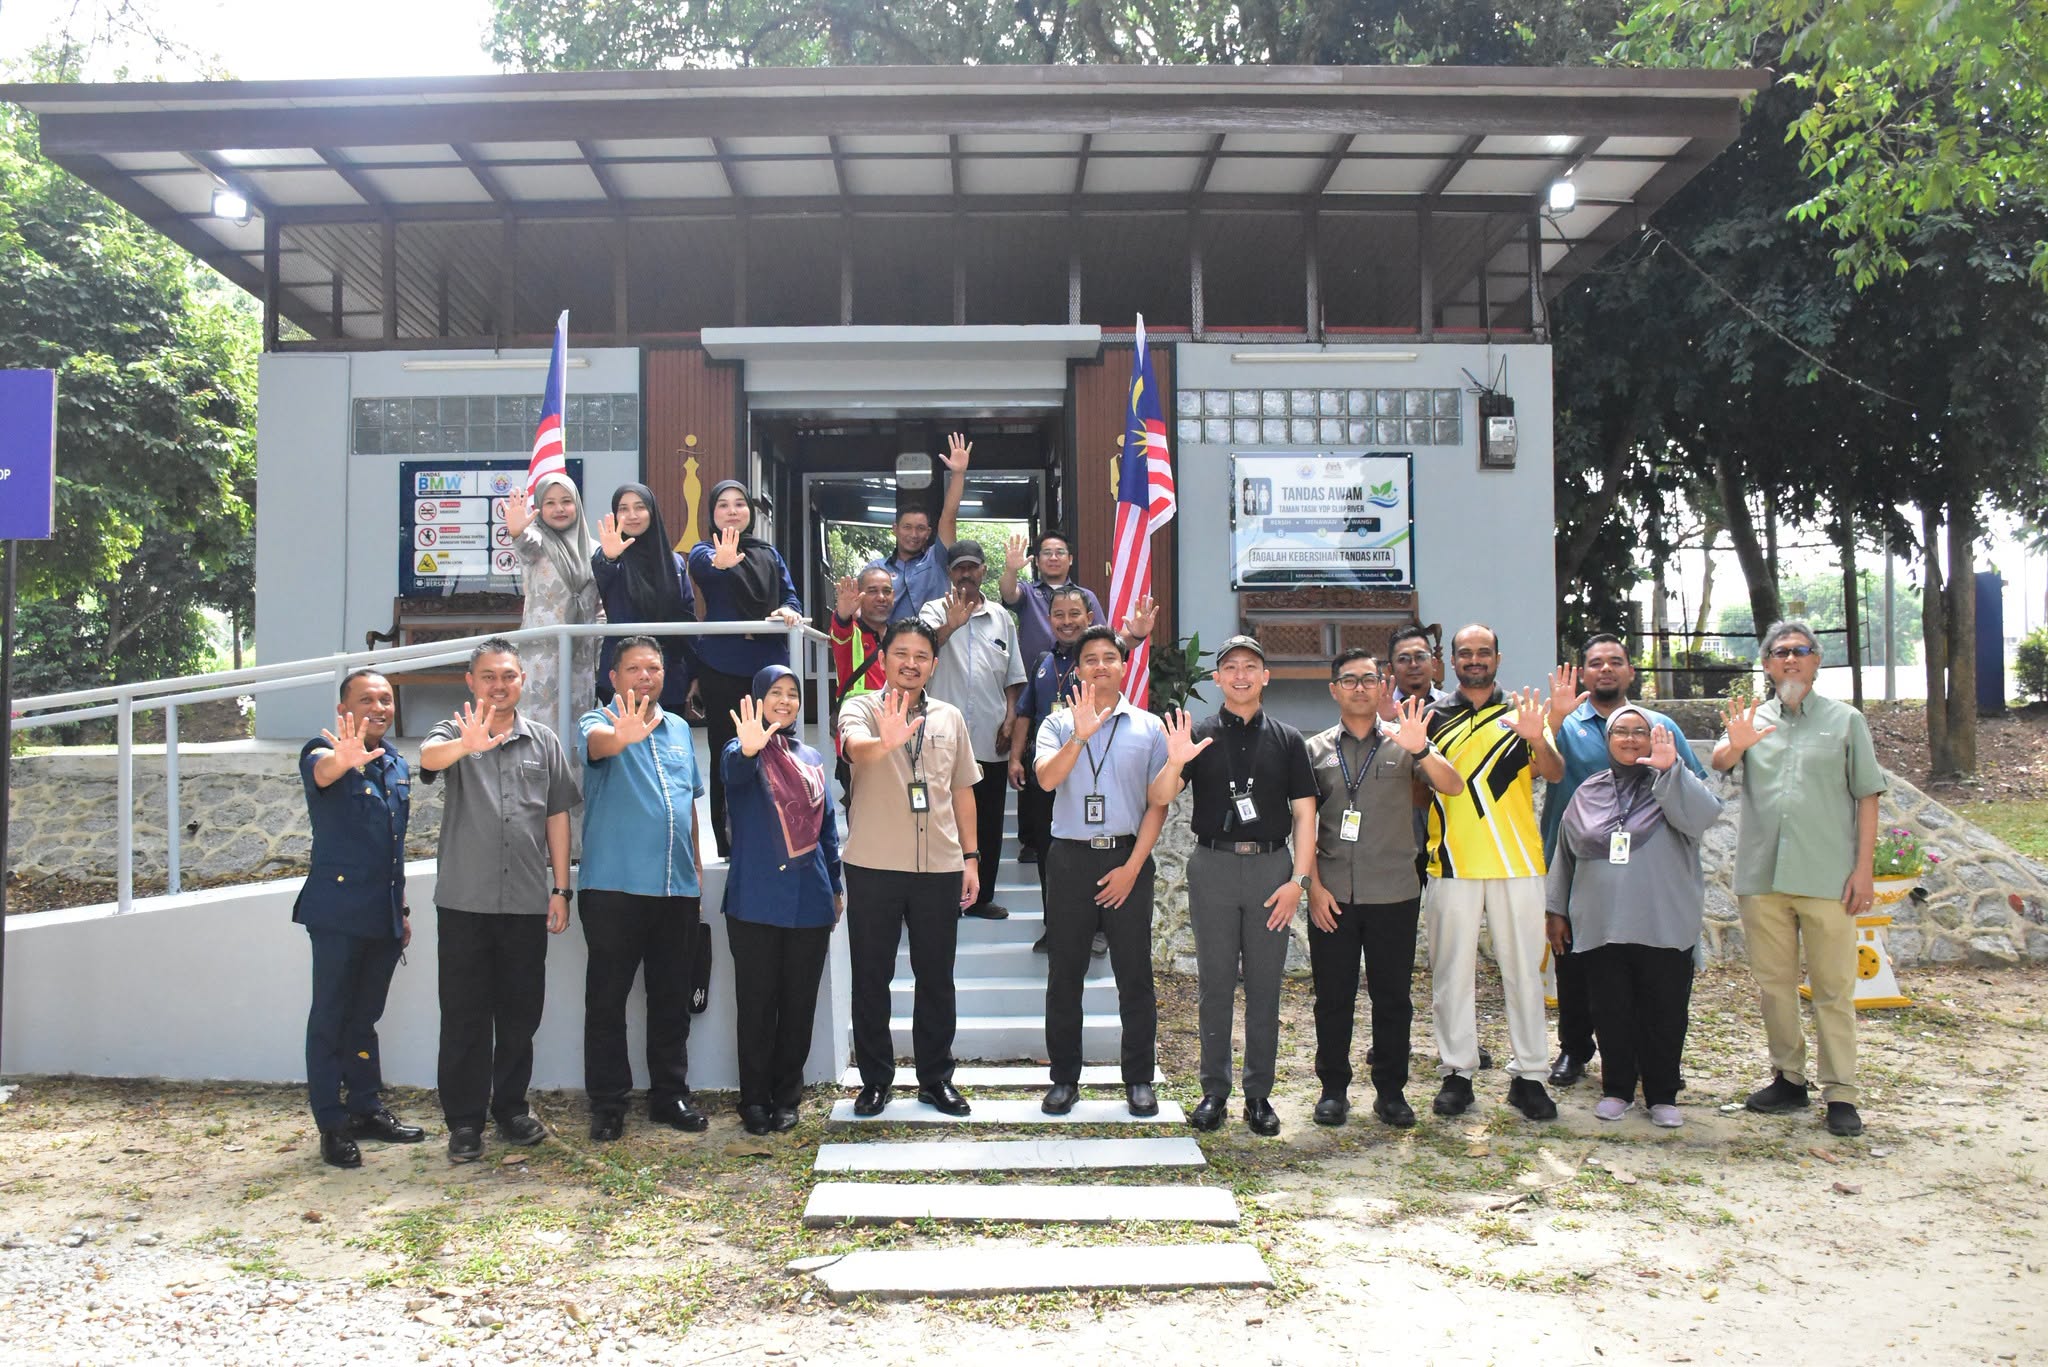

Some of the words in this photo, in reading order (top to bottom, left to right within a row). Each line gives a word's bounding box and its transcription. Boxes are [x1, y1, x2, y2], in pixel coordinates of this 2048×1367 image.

[419, 477, 461, 489] BMW
[1281, 487, 1325, 501] TANDAS
[1328, 486, 1363, 500] AWAM
[1347, 505, 1364, 513] RIVER
[1252, 552, 1287, 561] JAGALAH
[1288, 551, 1337, 561] KEBERSIHAN
[1340, 551, 1370, 561] TANDAS
[1373, 551, 1390, 561] KITA
